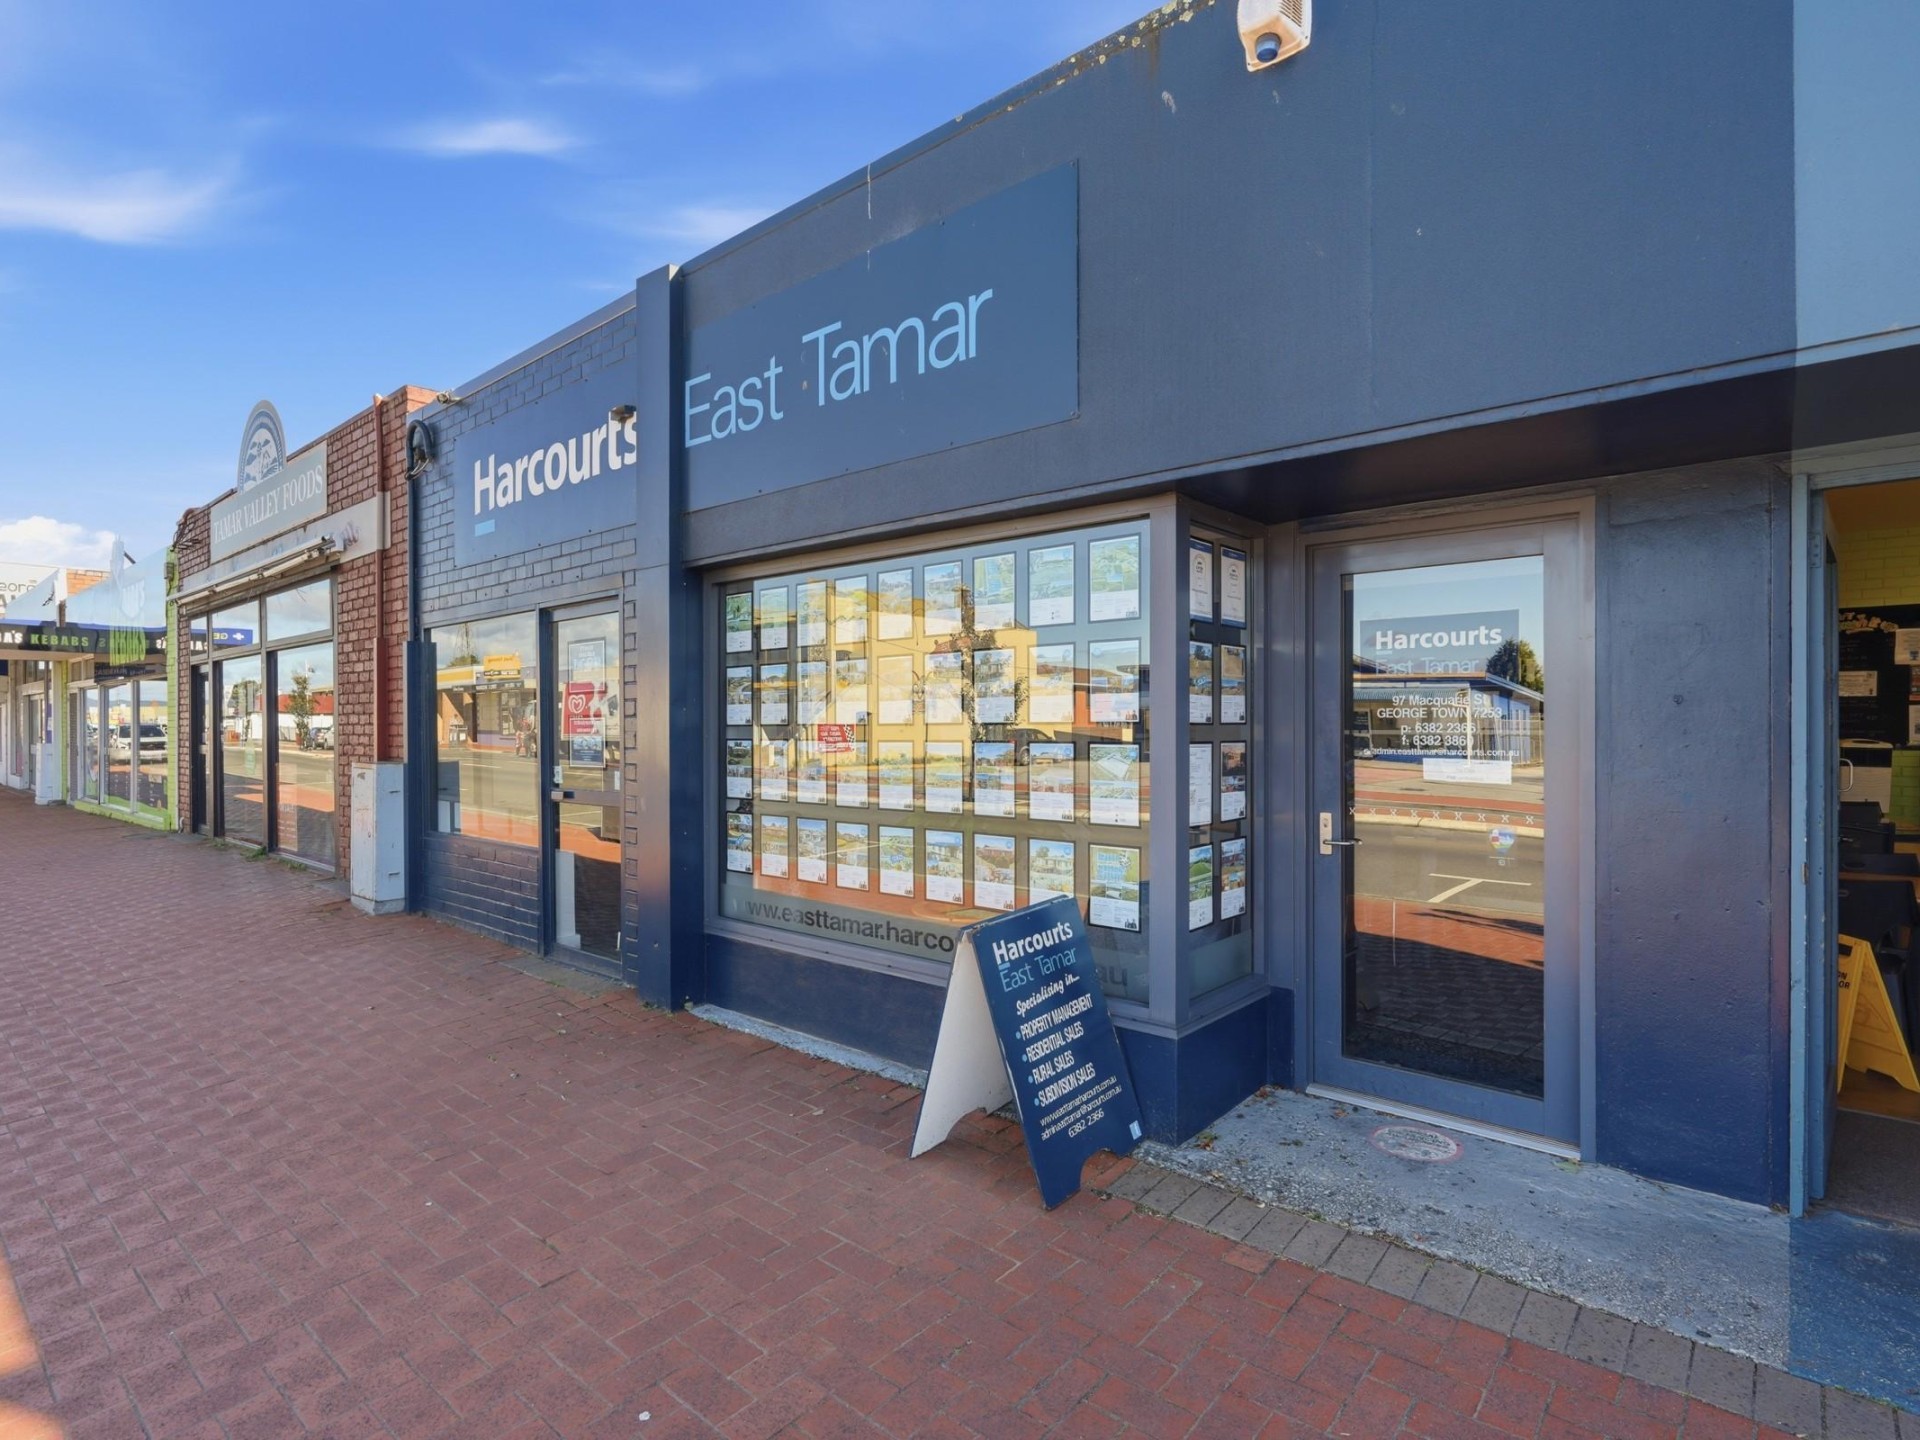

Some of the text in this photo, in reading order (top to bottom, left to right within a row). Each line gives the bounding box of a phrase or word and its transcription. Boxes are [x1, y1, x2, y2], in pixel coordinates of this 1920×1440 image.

[684, 288, 994, 449] East Tamar
[474, 411, 637, 516] Harcourts
[213, 464, 323, 544] TAMAR VALLEY FOODS
[30, 633, 89, 647] KEBABS
[1375, 625, 1502, 650] Harcourts
[1375, 656, 1480, 675] East Tamar
[1376, 707, 1503, 719] GEORGE TOWN 7253
[1392, 693, 1490, 709] 97 Macquarie St
[1412, 735, 1442, 746] 6382
[1414, 722, 1443, 733] 6382
[992, 921, 1073, 965] Harcourts
[999, 947, 1077, 993] East Tamar
[1016, 979, 1064, 1018] Specialising
[1020, 993, 1093, 1041] PROPERTY MANAGEMENT
[1025, 1021, 1085, 1063] RESIDENTIAL SALES
[1032, 1050, 1075, 1085] RURAL SALES
[1038, 1062, 1096, 1107] SUBDIVISION SALES
[1068, 1119, 1086, 1138] 6382
